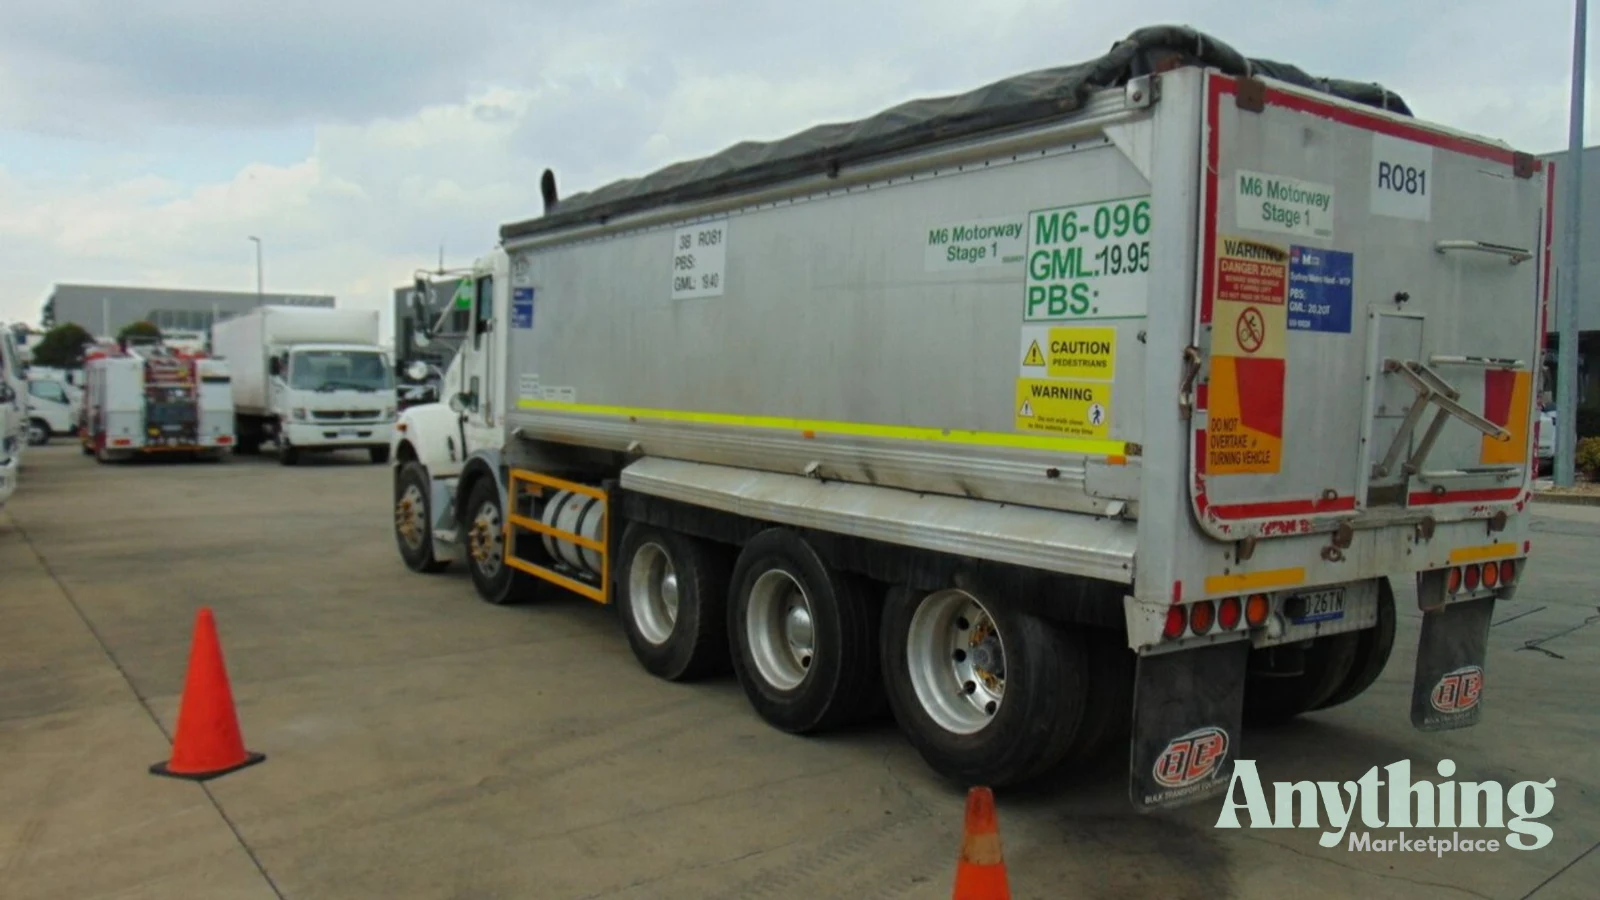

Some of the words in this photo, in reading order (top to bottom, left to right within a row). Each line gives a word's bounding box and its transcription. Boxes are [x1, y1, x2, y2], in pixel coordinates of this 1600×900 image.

[1240, 175, 1263, 197] M6
[1266, 179, 1330, 212] Motorway
[1035, 200, 1151, 246] M6-096
[1262, 201, 1301, 228] Stage
[1304, 208, 1310, 227] 1
[928, 228, 949, 246] M6
[952, 222, 1023, 243] Motorway
[946, 245, 987, 264] Stage
[991, 240, 998, 258] 1
[1220, 260, 1259, 276] DANGER
[1260, 264, 1285, 279] ZONE
[1027, 282, 1100, 317] PBS:
[1051, 340, 1110, 355] CAUTION
[1052, 358, 1108, 369] PEDESTRIANS
[1031, 384, 1093, 402] WARNING
[1211, 417, 1222, 433] DO
[1223, 416, 1239, 432] NOT
